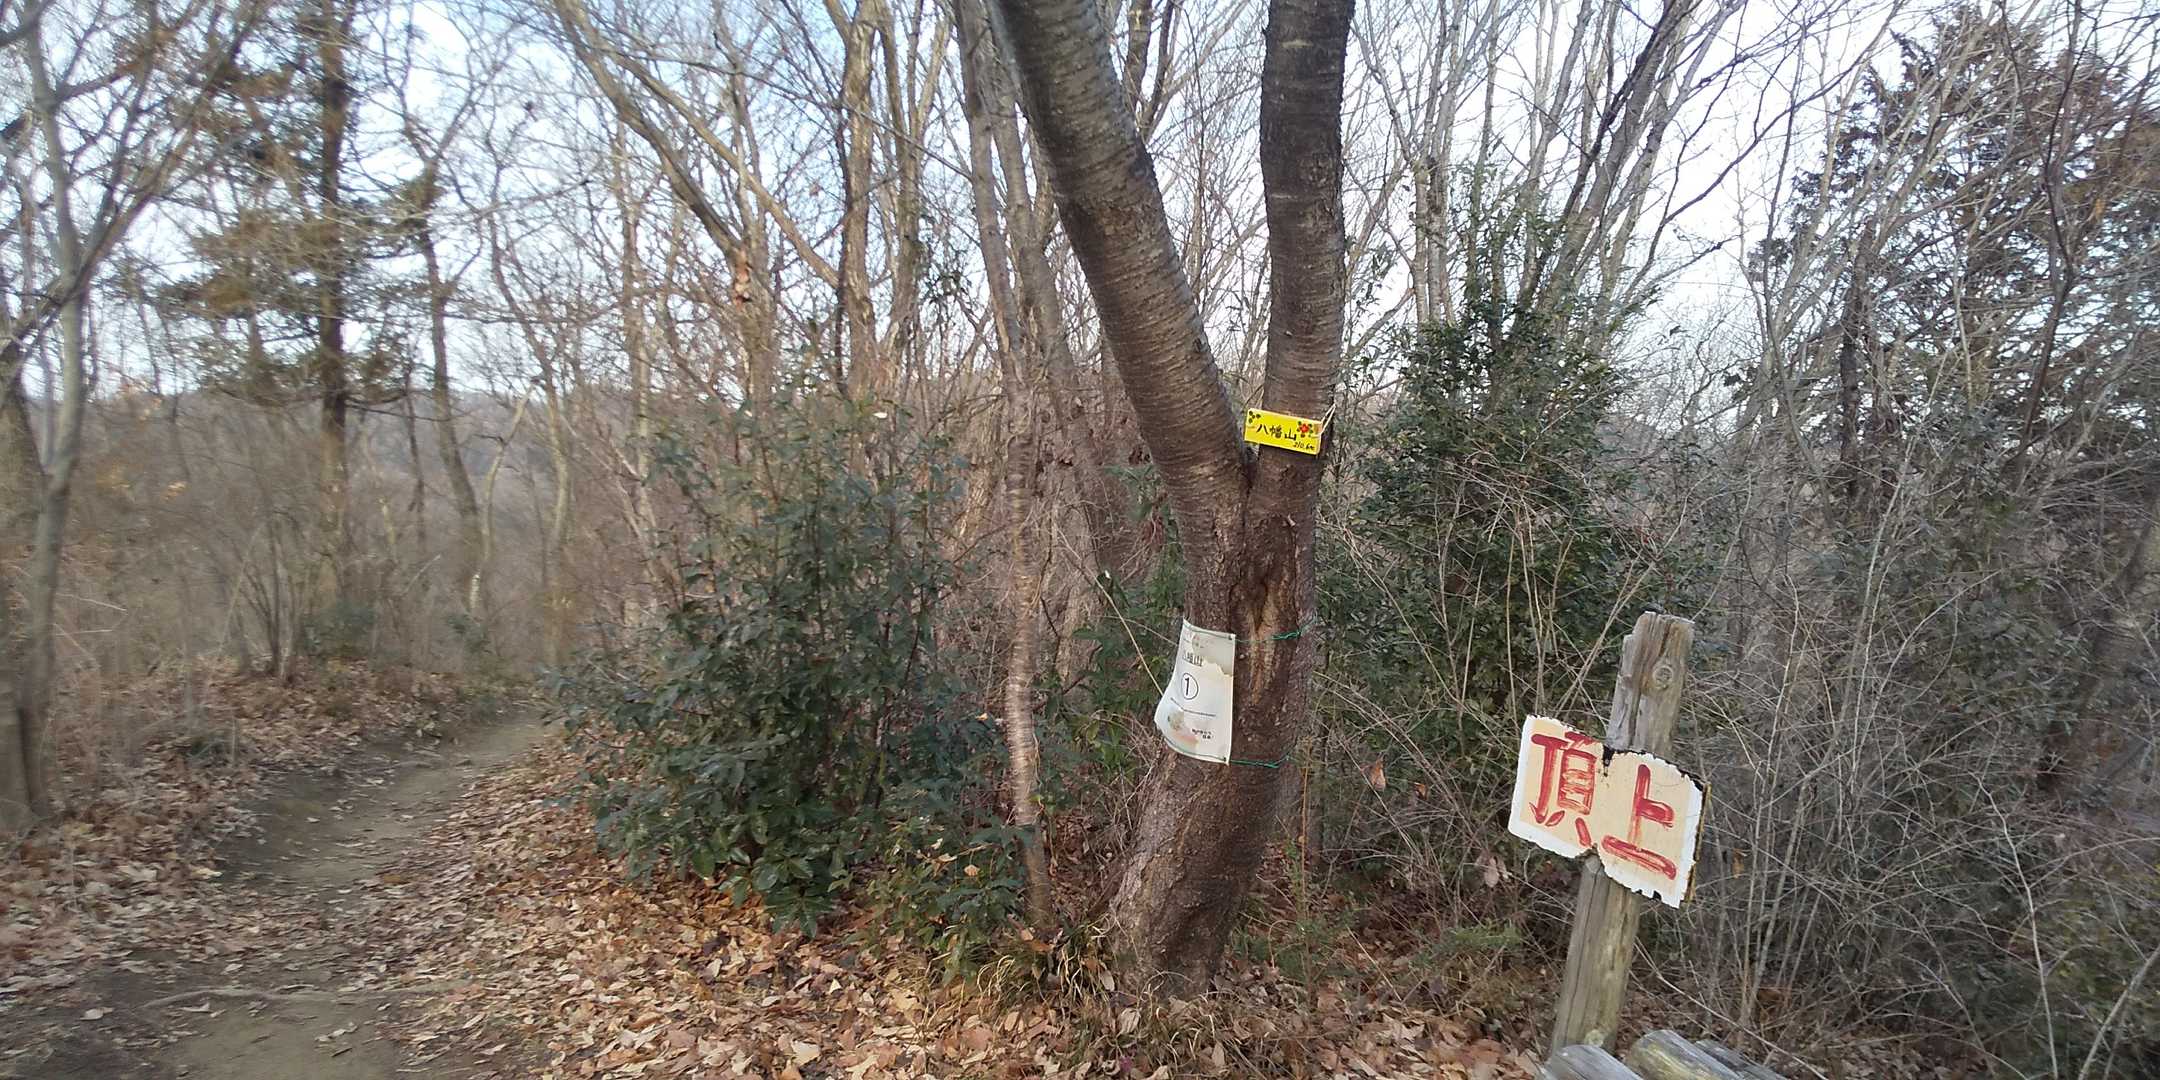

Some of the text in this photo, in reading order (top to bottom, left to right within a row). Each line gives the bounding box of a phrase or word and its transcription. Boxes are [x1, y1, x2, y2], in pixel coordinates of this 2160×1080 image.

[1256, 424, 1297, 441] 八幡山
[1529, 731, 1678, 881] 頂上
